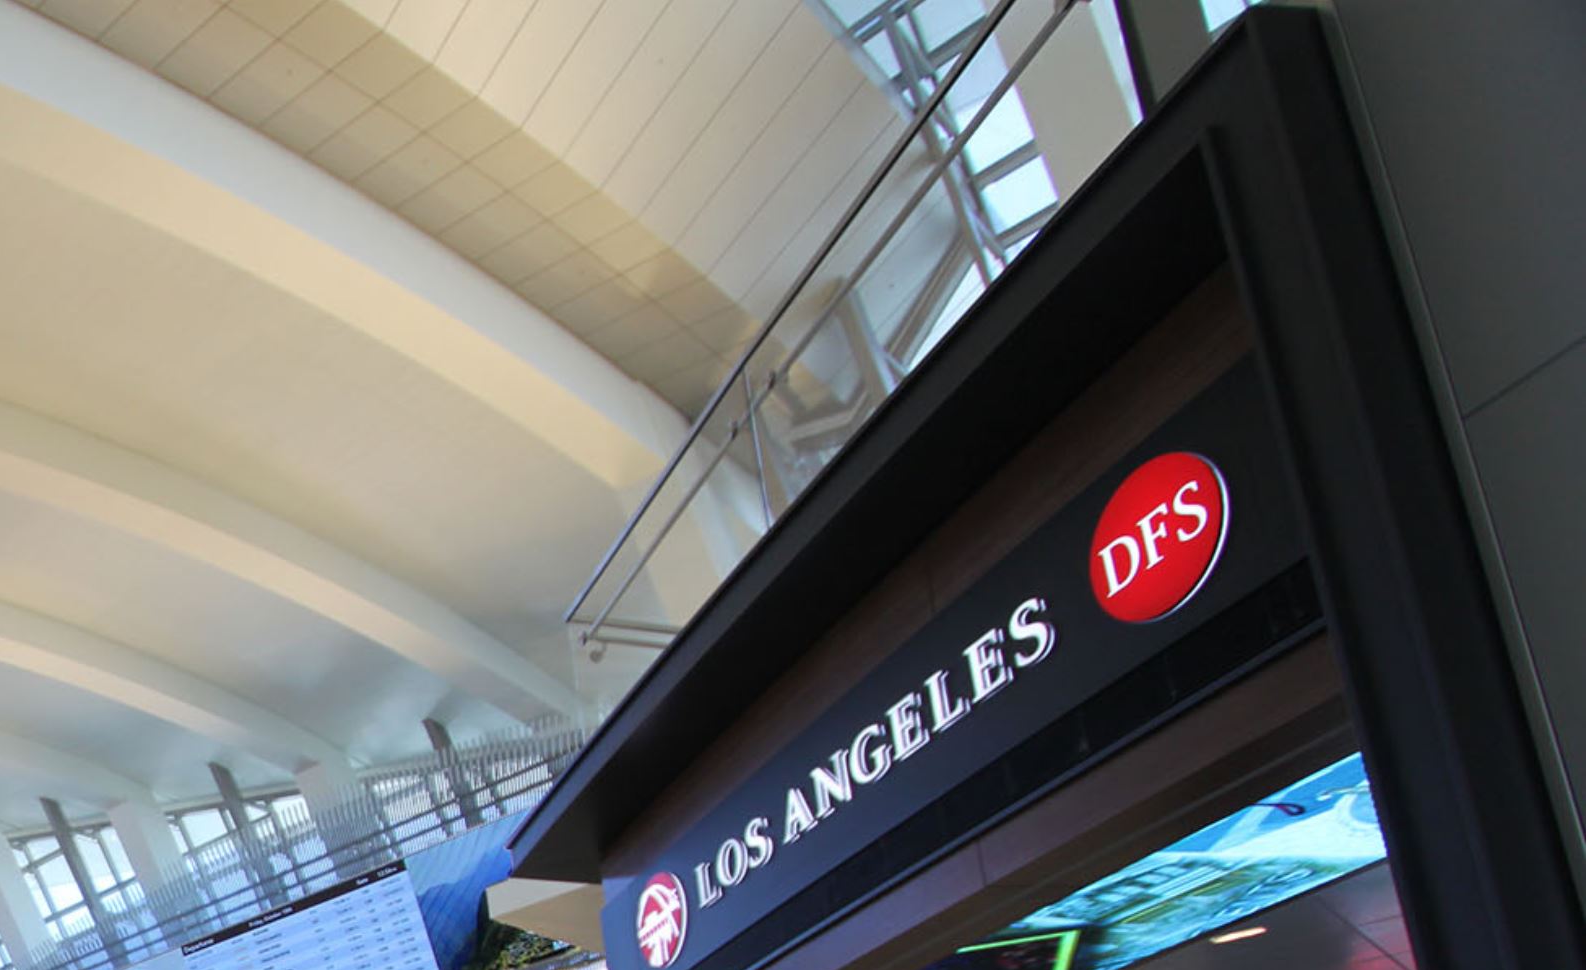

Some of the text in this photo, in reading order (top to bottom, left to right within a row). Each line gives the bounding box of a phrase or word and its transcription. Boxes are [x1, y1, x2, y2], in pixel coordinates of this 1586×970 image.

[1097, 480, 1209, 599] DFS
[693, 597, 1056, 909] LOS ANGELES
